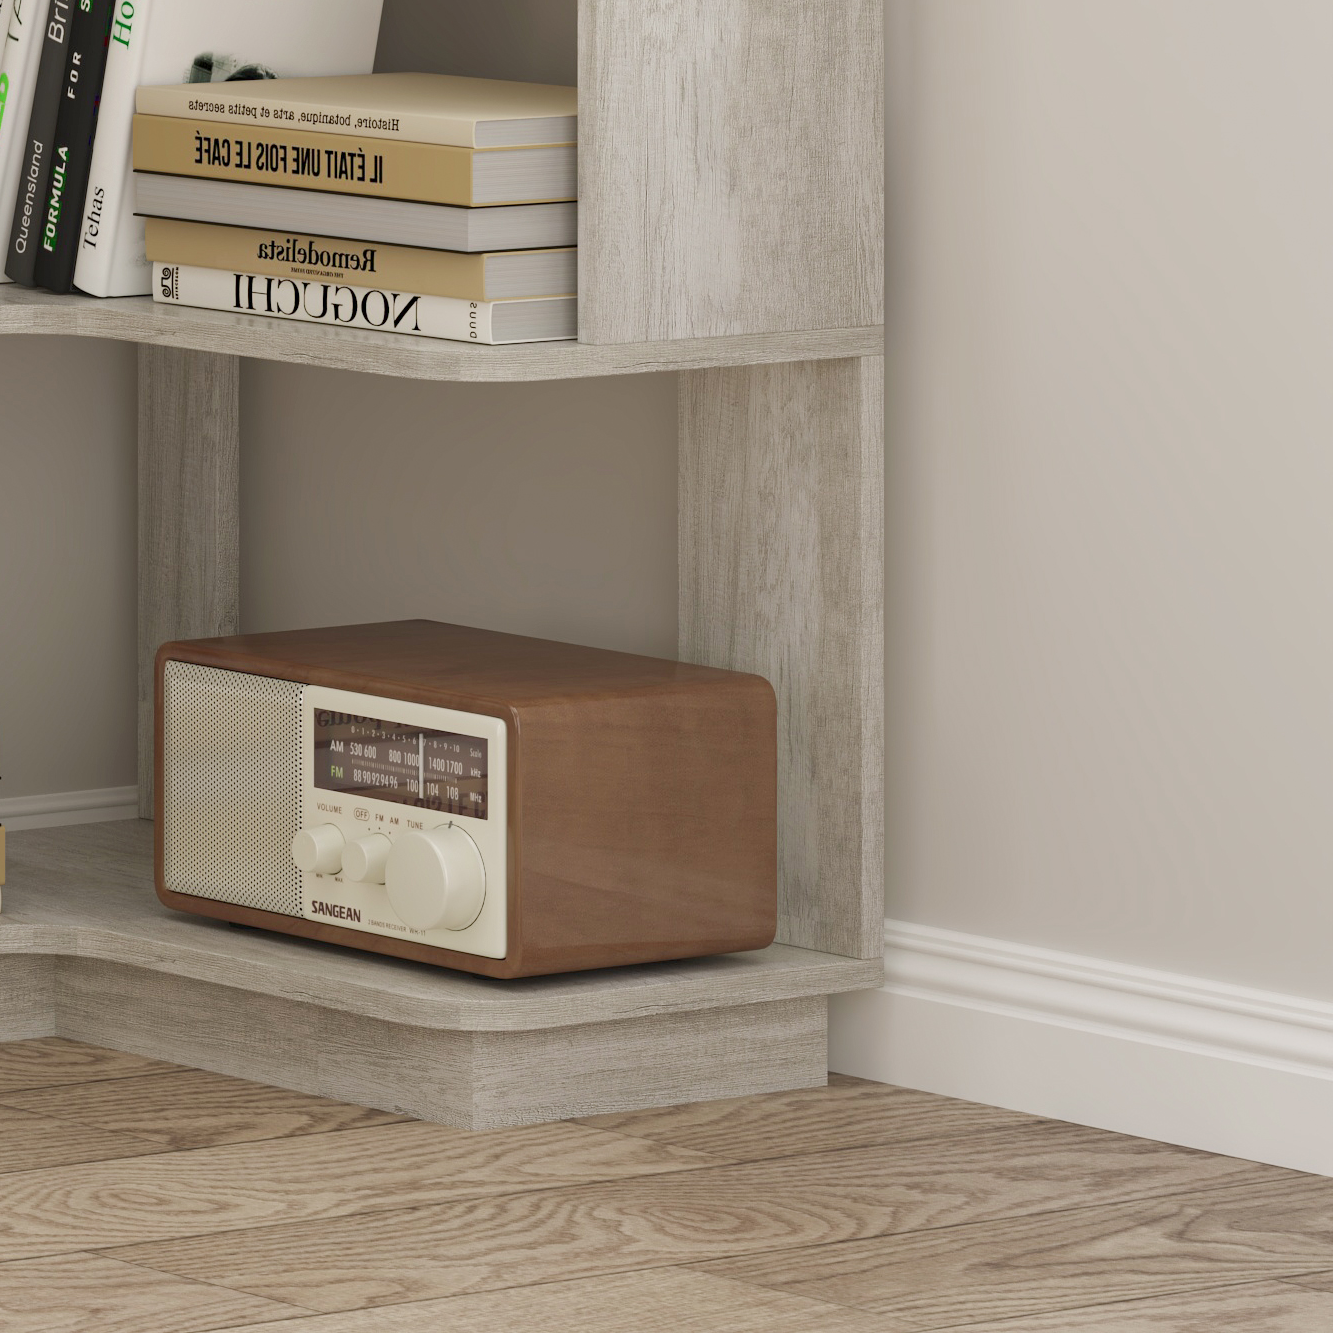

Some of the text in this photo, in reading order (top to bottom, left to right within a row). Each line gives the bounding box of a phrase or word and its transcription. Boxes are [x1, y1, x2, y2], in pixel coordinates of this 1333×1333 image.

[43, 145, 70, 252] FORMULA
[67, 51, 82, 100] FOR
[14, 140, 44, 254] Queensland
[82, 185, 105, 251] Tehas
[330, 740, 463, 775] AM 530 600 800 1700
[330, 765, 344, 779] FM
[317, 802, 343, 815] VOLUME
[355, 809, 368, 819] OFF
[406, 819, 424, 830] TUNE
[311, 900, 361, 923] SANGEAN
